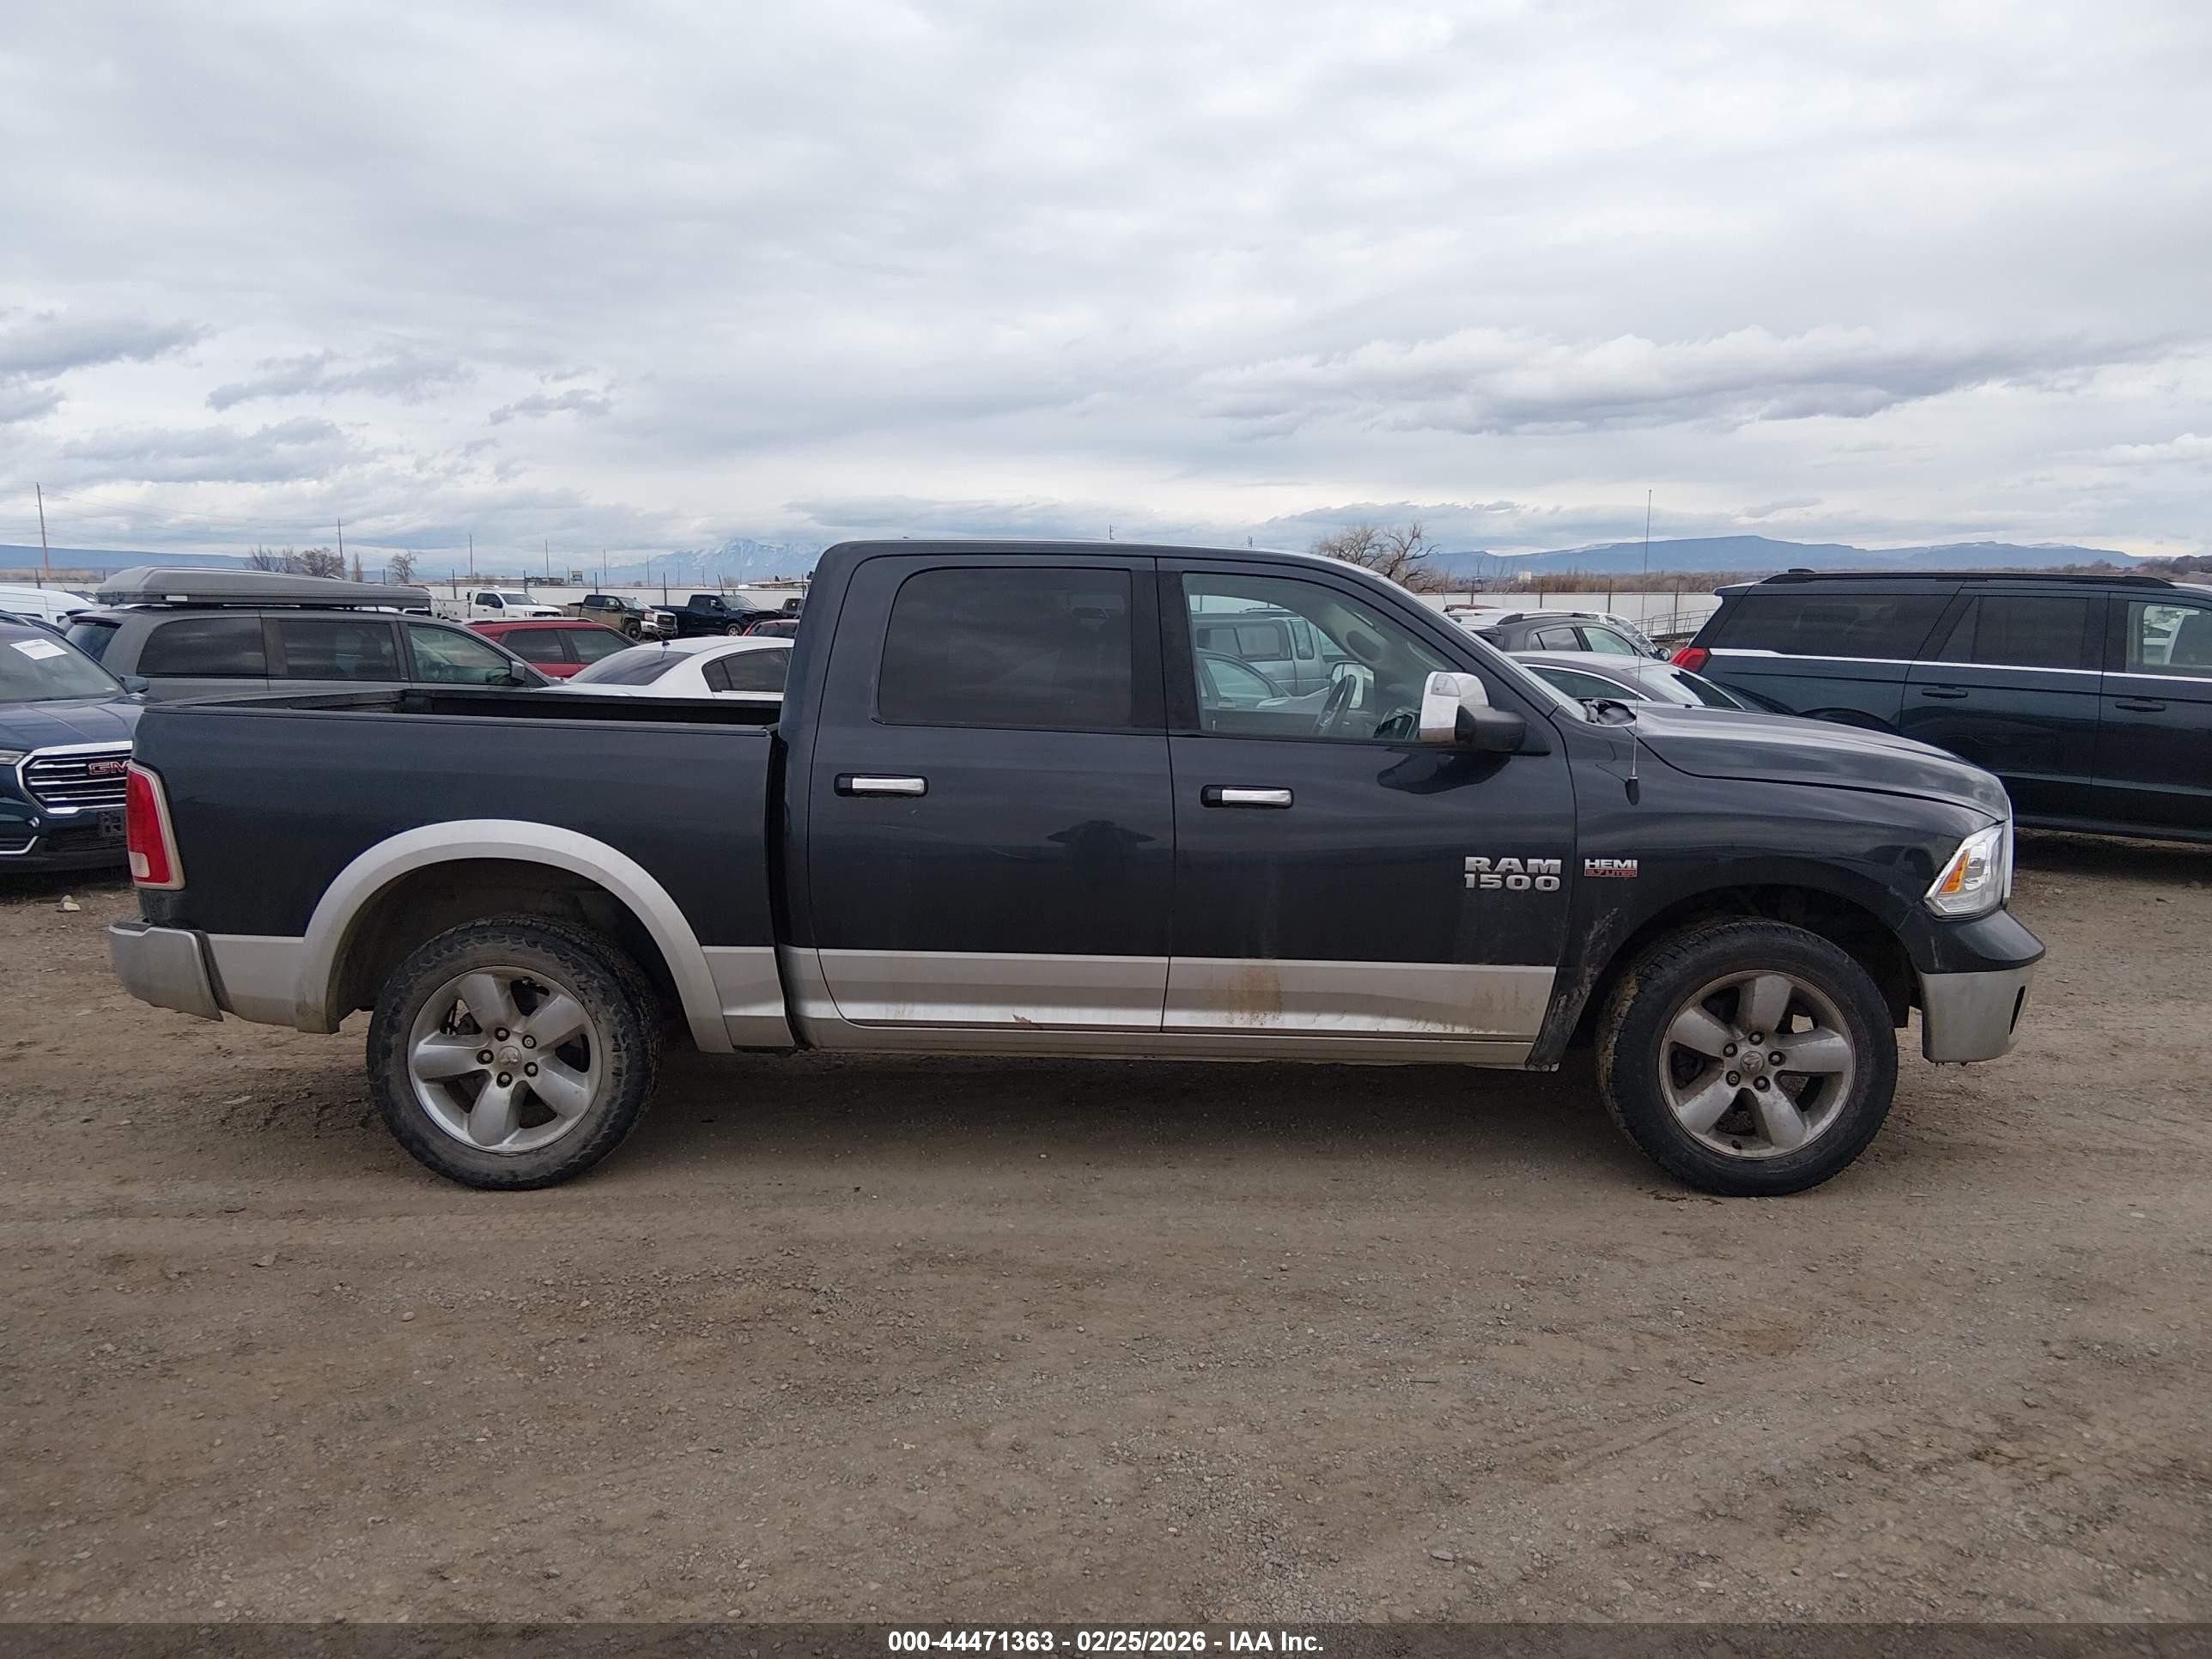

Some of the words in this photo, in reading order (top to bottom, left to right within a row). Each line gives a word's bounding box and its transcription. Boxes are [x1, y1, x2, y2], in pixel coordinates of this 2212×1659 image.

[88, 760, 129, 775] GM
[1464, 856, 1561, 874] RAM
[1584, 859, 1638, 869] HEMI
[1464, 873, 1560, 891] 1500
